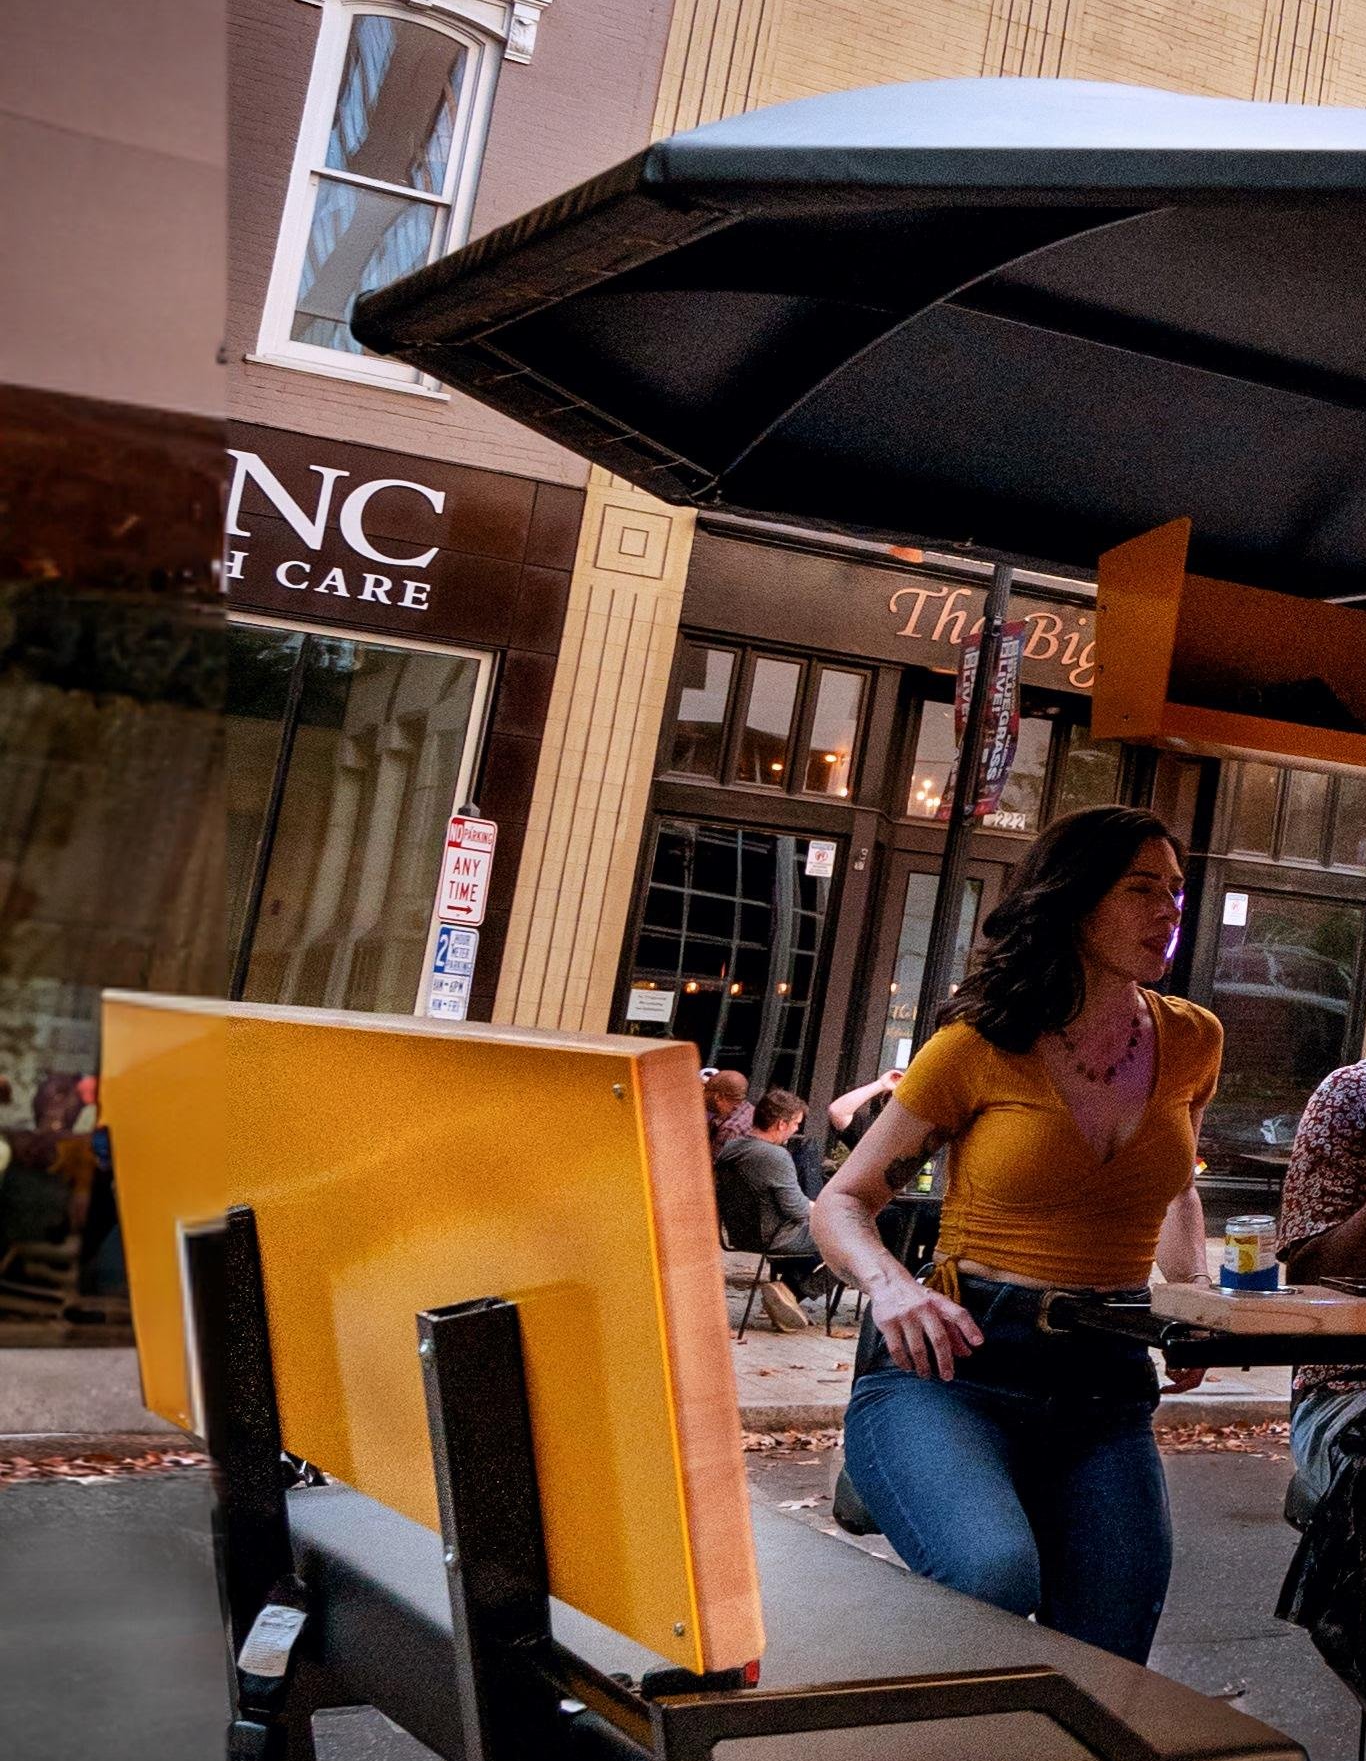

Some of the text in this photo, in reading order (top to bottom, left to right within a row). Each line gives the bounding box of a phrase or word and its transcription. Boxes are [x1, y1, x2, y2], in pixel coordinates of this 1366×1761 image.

[275, 560, 432, 611] CARE
[448, 823, 464, 843] NO
[453, 856, 481, 877] ANY
[449, 880, 478, 903] TIME
[435, 933, 449, 968] 2
